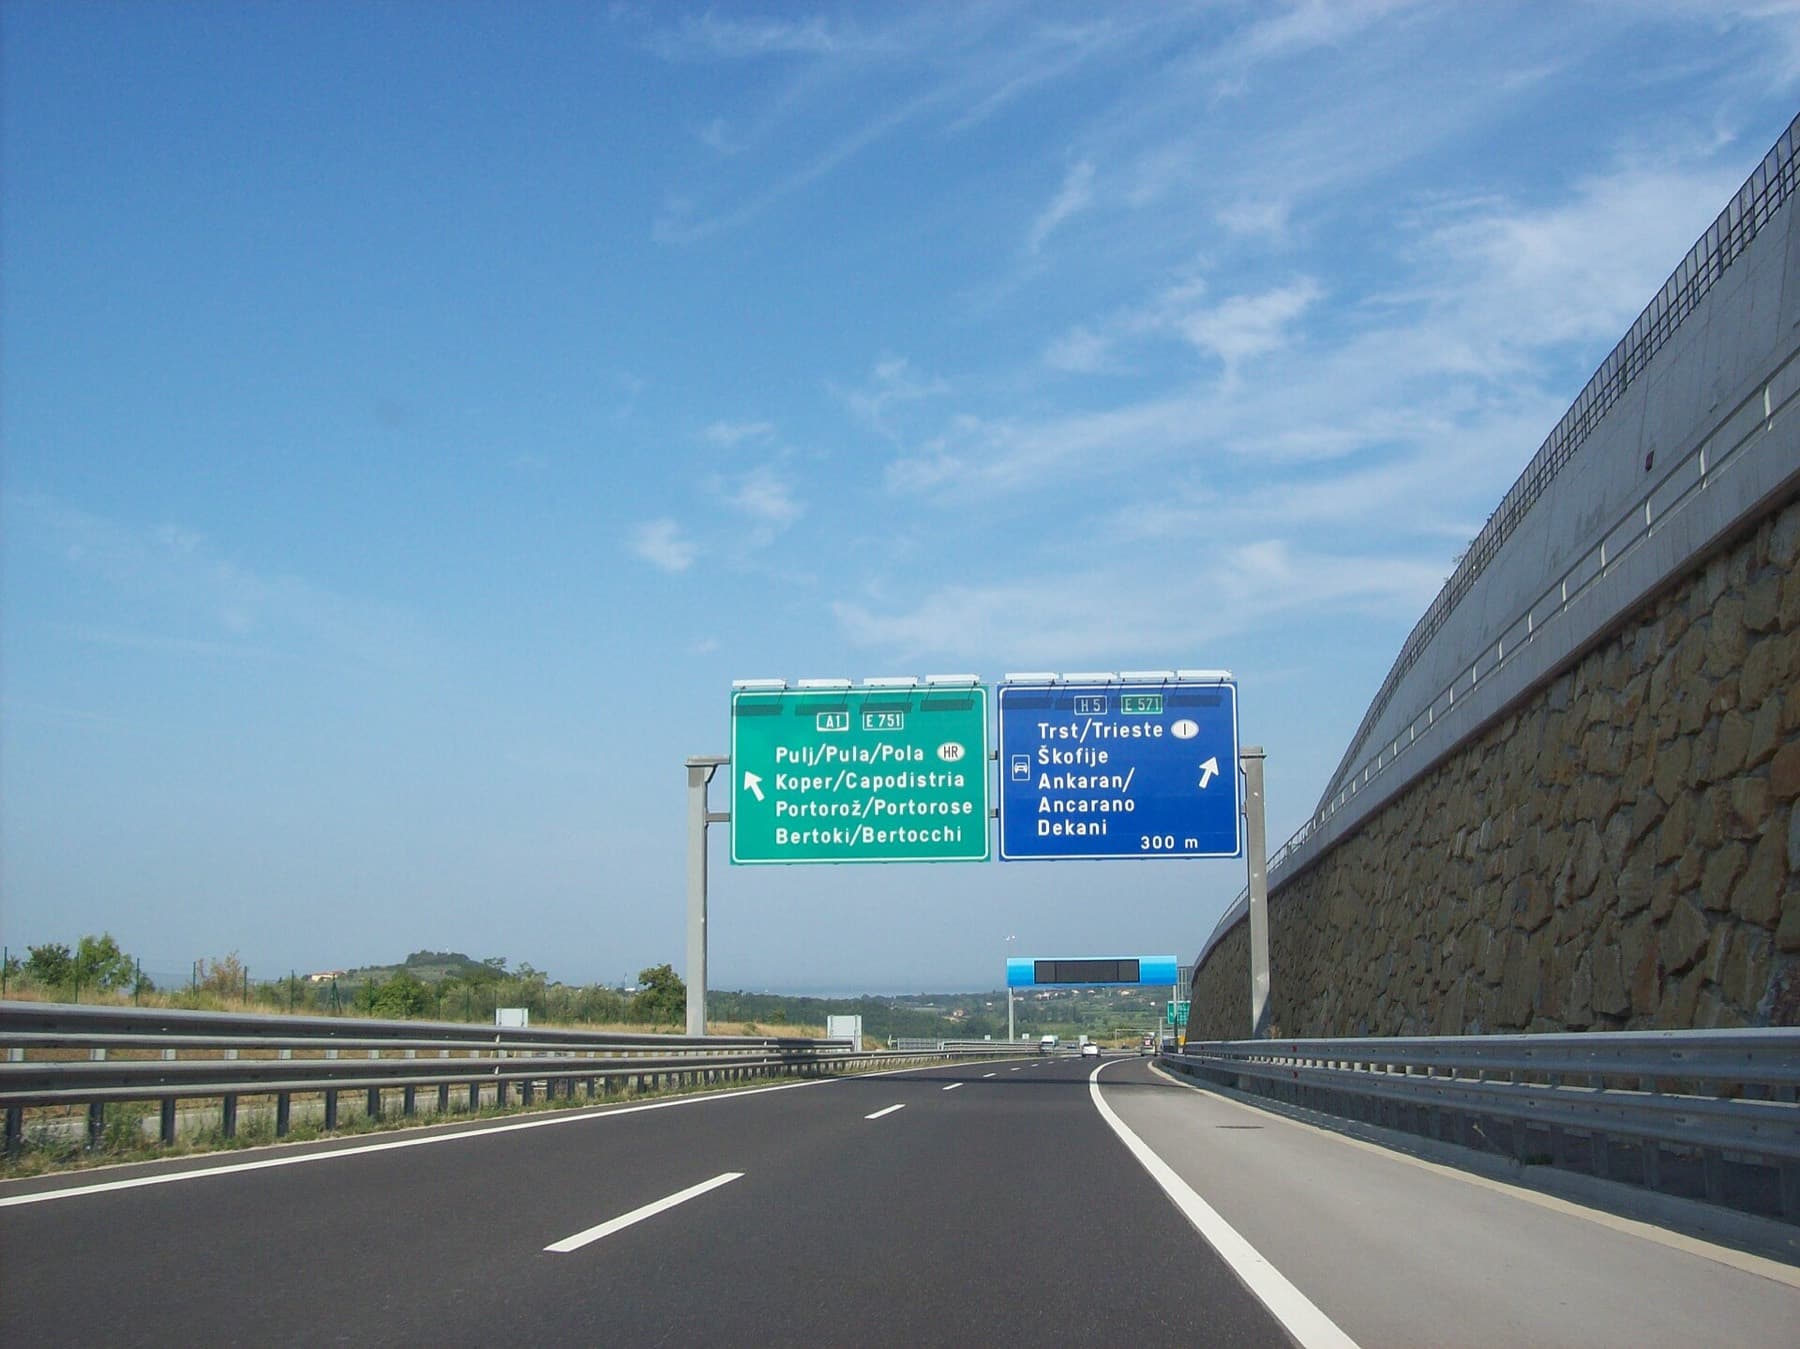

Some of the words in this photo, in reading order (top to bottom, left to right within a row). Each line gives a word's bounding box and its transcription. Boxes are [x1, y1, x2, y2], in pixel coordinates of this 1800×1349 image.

[1080, 699, 1089, 713] H
[1092, 698, 1101, 712] 5
[1125, 698, 1133, 712] E
[1138, 697, 1160, 712] 571
[826, 714, 841, 728] A1
[866, 714, 873, 728] E
[878, 713, 901, 728] 751
[1037, 718, 1164, 743] Trst/Trieste
[775, 742, 924, 767] Pulj/Pula/Pola
[942, 745, 959, 759] HR
[1037, 745, 1109, 767] Škofije
[775, 769, 965, 793] Koper/Capodistria
[1038, 767, 1135, 793] Ankaran/
[775, 796, 973, 819] Portorož/Portorose
[1038, 796, 1136, 813] Ancarano
[775, 824, 962, 846] Bertoki/Bertocchi
[1037, 819, 1107, 836] Dekani
[1140, 835, 1175, 849] 300
[1184, 838, 1198, 849] m
